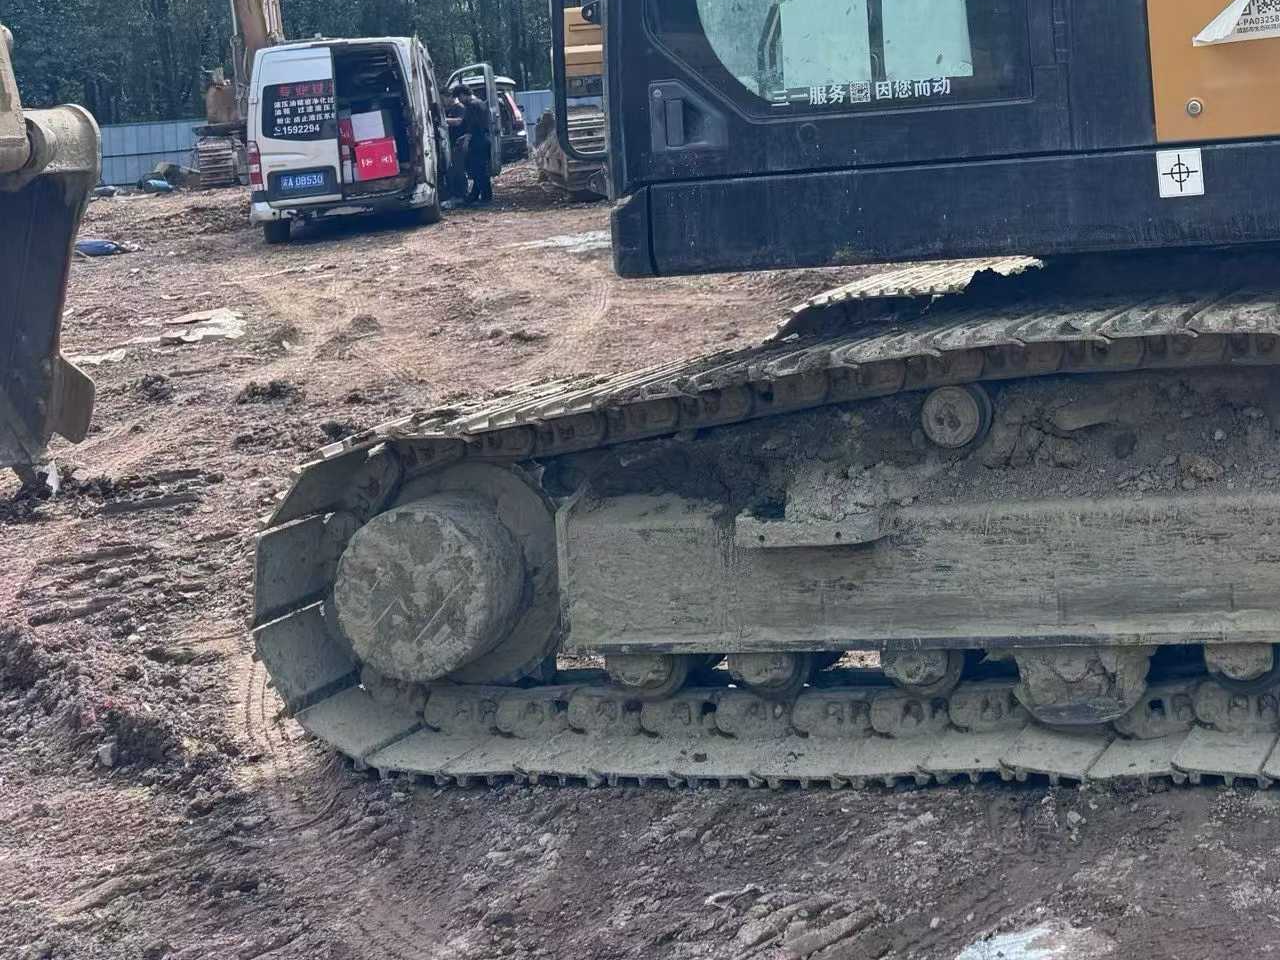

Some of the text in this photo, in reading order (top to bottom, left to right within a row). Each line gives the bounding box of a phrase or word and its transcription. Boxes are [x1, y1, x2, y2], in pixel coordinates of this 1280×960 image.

[771, 76, 951, 107] 三一服务 因您而动
